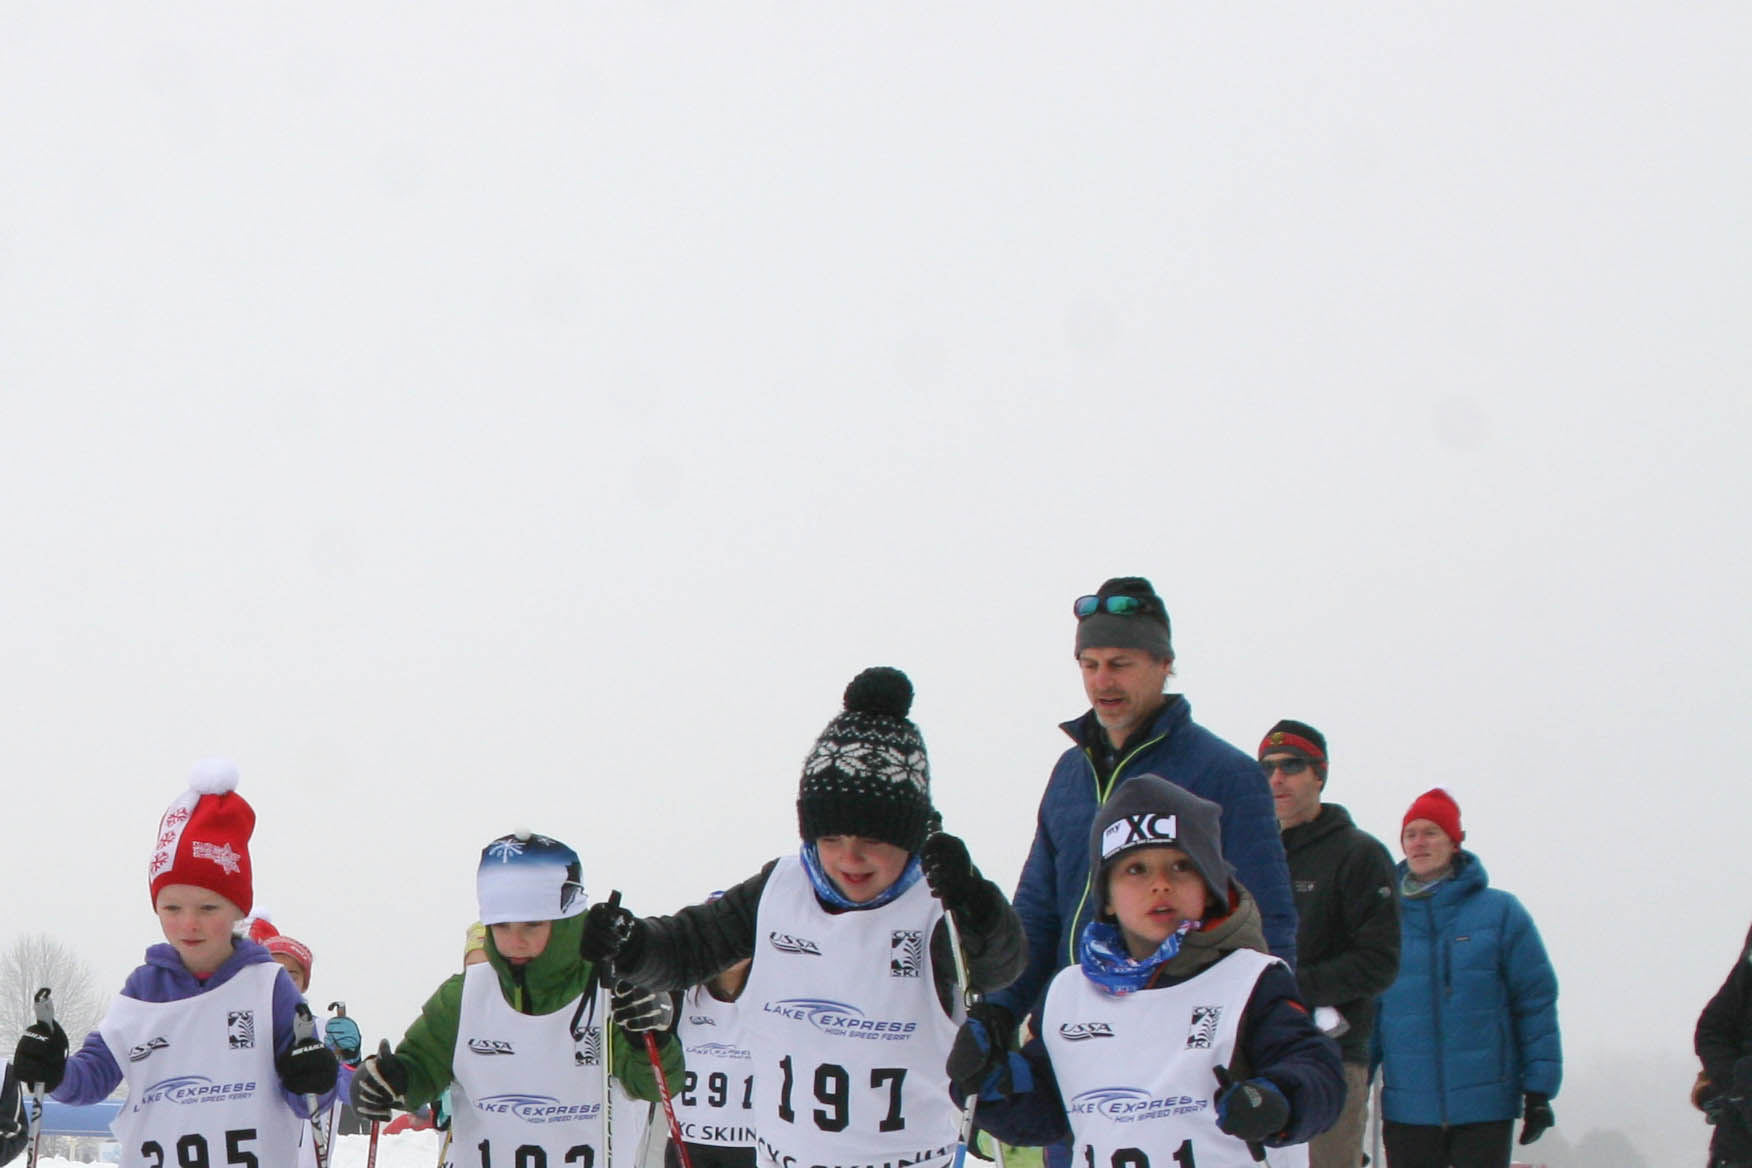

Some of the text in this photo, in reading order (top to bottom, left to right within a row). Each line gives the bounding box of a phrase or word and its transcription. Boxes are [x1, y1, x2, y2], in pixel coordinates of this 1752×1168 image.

[1125, 813, 1171, 845] XC
[769, 931, 820, 950] USSA
[893, 930, 921, 940] CXC
[892, 968, 919, 977] SKI
[229, 1011, 254, 1019] CXC
[1195, 1006, 1221, 1015] CXC
[764, 1002, 918, 1033] LAKE EXPRESS
[1059, 1022, 1113, 1033] USSA
[824, 1028, 912, 1041] HIGH SPEED FERRY
[230, 1042, 255, 1050] SKI
[468, 1038, 513, 1050] USSA
[176, 1082, 256, 1098] EXPRESS
[681, 1070, 753, 1109] 291
[778, 1054, 908, 1133] 197
[201, 1096, 227, 1104] SPEED
[228, 1092, 253, 1101] FERRY
[477, 1102, 601, 1117] AKE EXPRESS
[1138, 1109, 1171, 1120] SPEED
[701, 1125, 757, 1141] SKIIN
